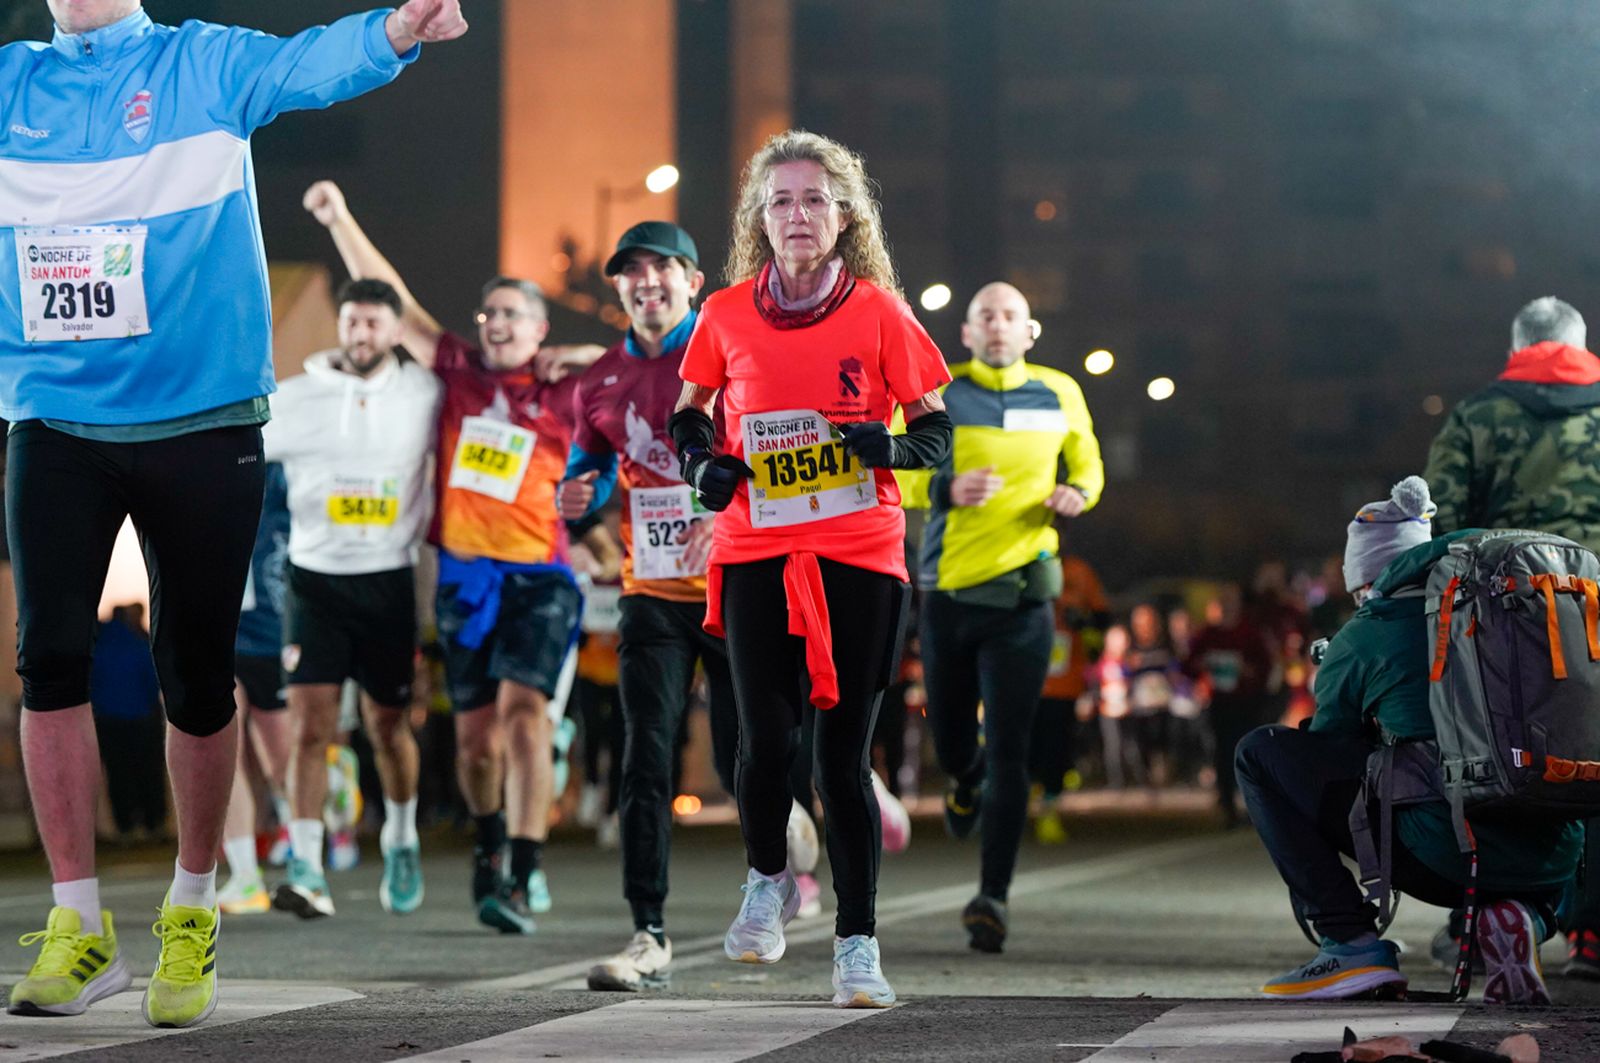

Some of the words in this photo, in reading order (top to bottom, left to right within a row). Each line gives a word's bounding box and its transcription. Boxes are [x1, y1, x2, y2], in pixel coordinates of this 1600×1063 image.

[41, 250, 73, 263] NOCHE
[31, 266, 49, 280] SAN
[41, 281, 115, 319] 2319
[62, 323, 93, 332] Salvador
[767, 421, 800, 436] NOCHE
[803, 420, 817, 430] DE
[648, 448, 671, 470] 43
[763, 441, 851, 487] 13547
